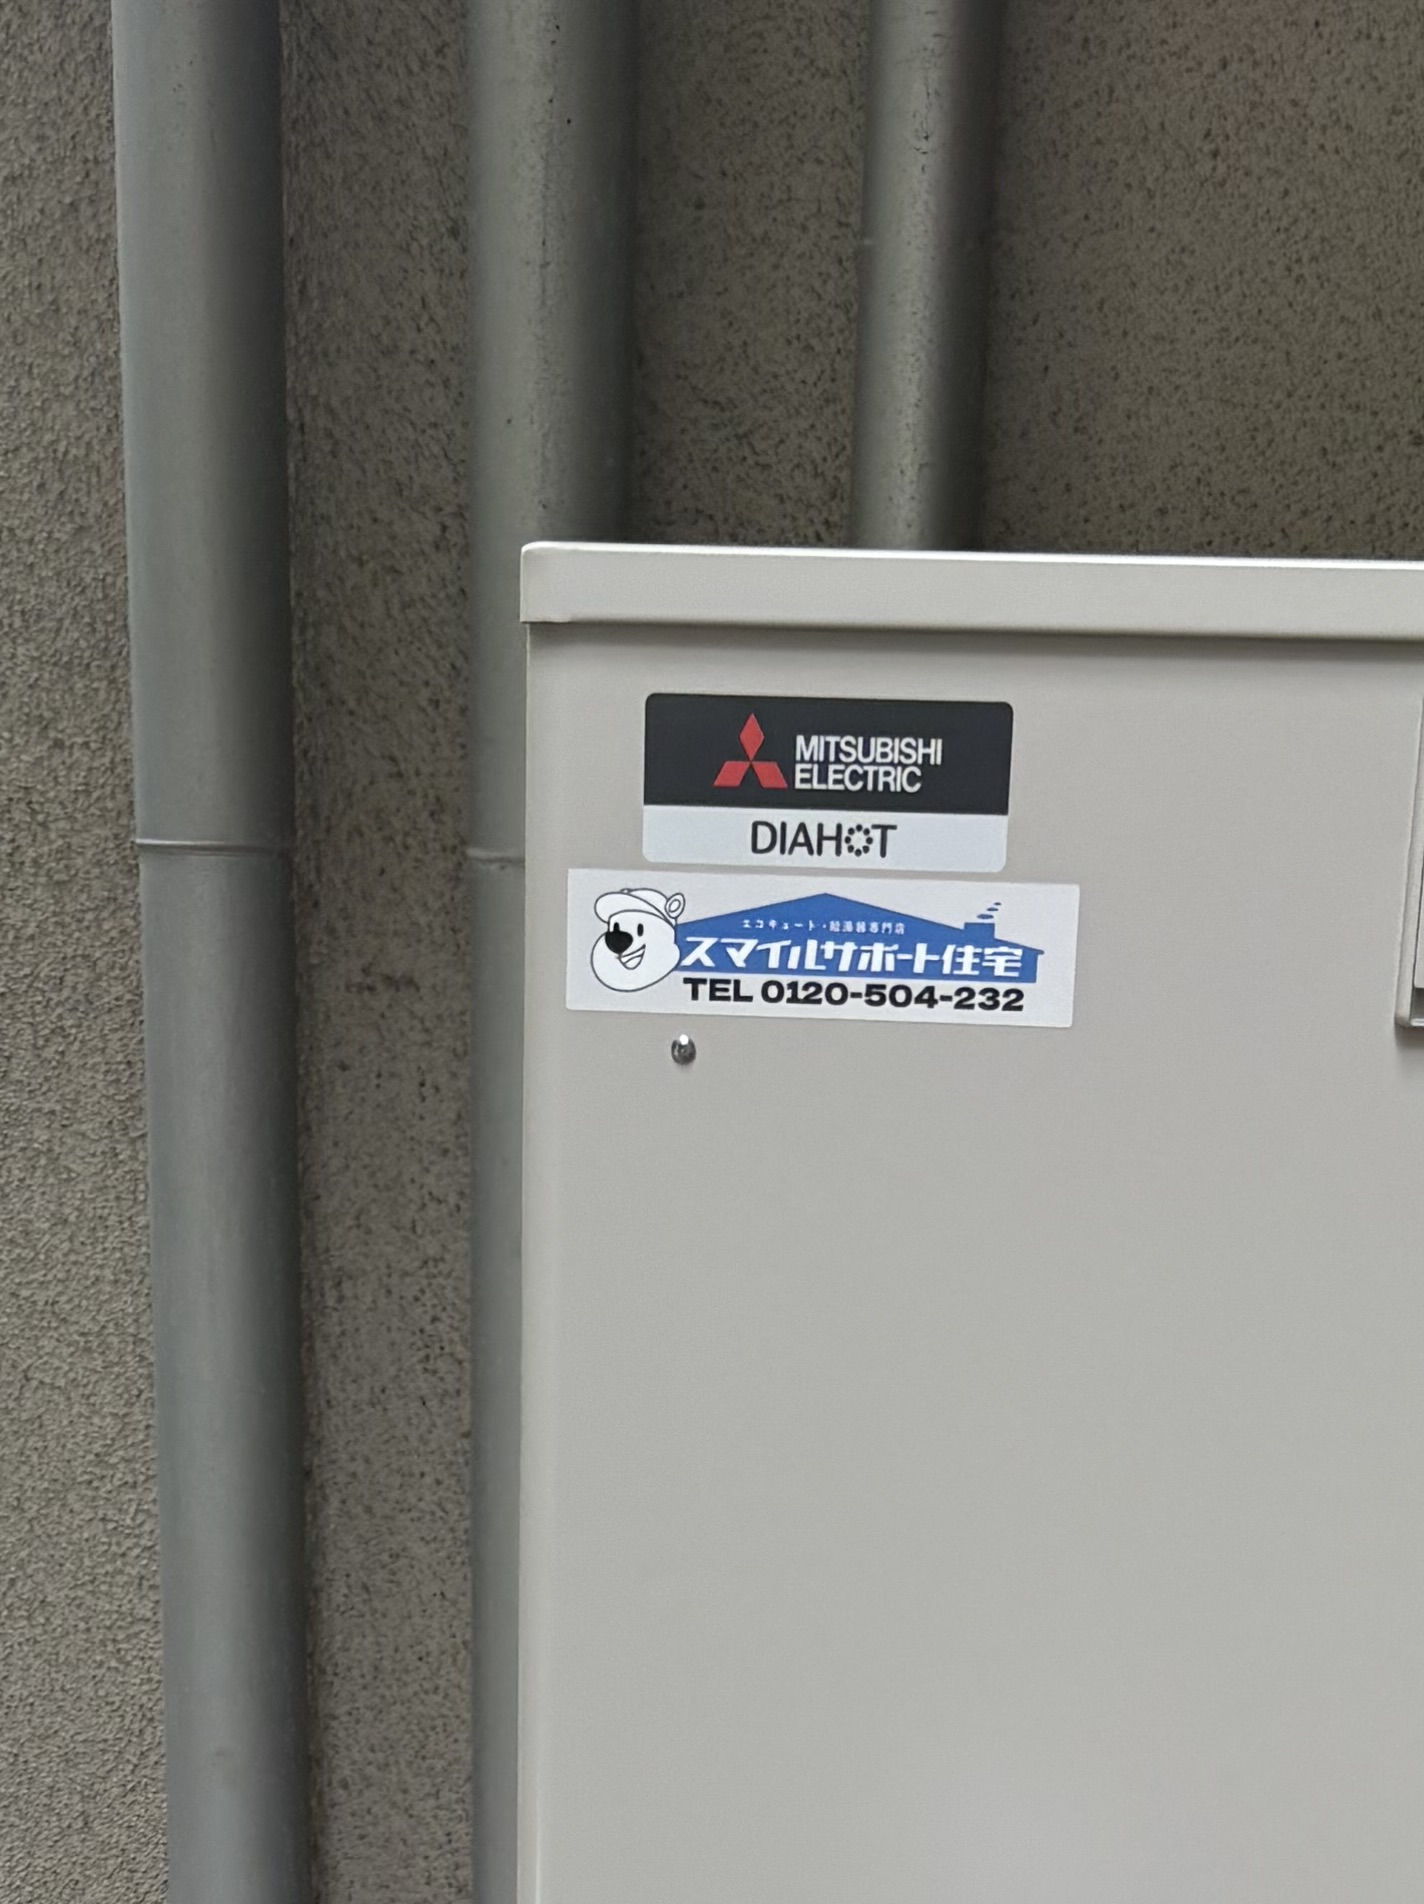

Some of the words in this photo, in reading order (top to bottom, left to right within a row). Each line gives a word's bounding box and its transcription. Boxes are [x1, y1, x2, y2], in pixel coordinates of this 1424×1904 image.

[794, 735, 943, 766] MITSUBISHI
[794, 763, 922, 794] ELECTRIC
[750, 820, 898, 859] DIAHOT
[679, 936, 1024, 978] スマイルサポート住宅
[682, 977, 754, 1004] TEL
[760, 979, 1025, 1012] 0120-504-232
